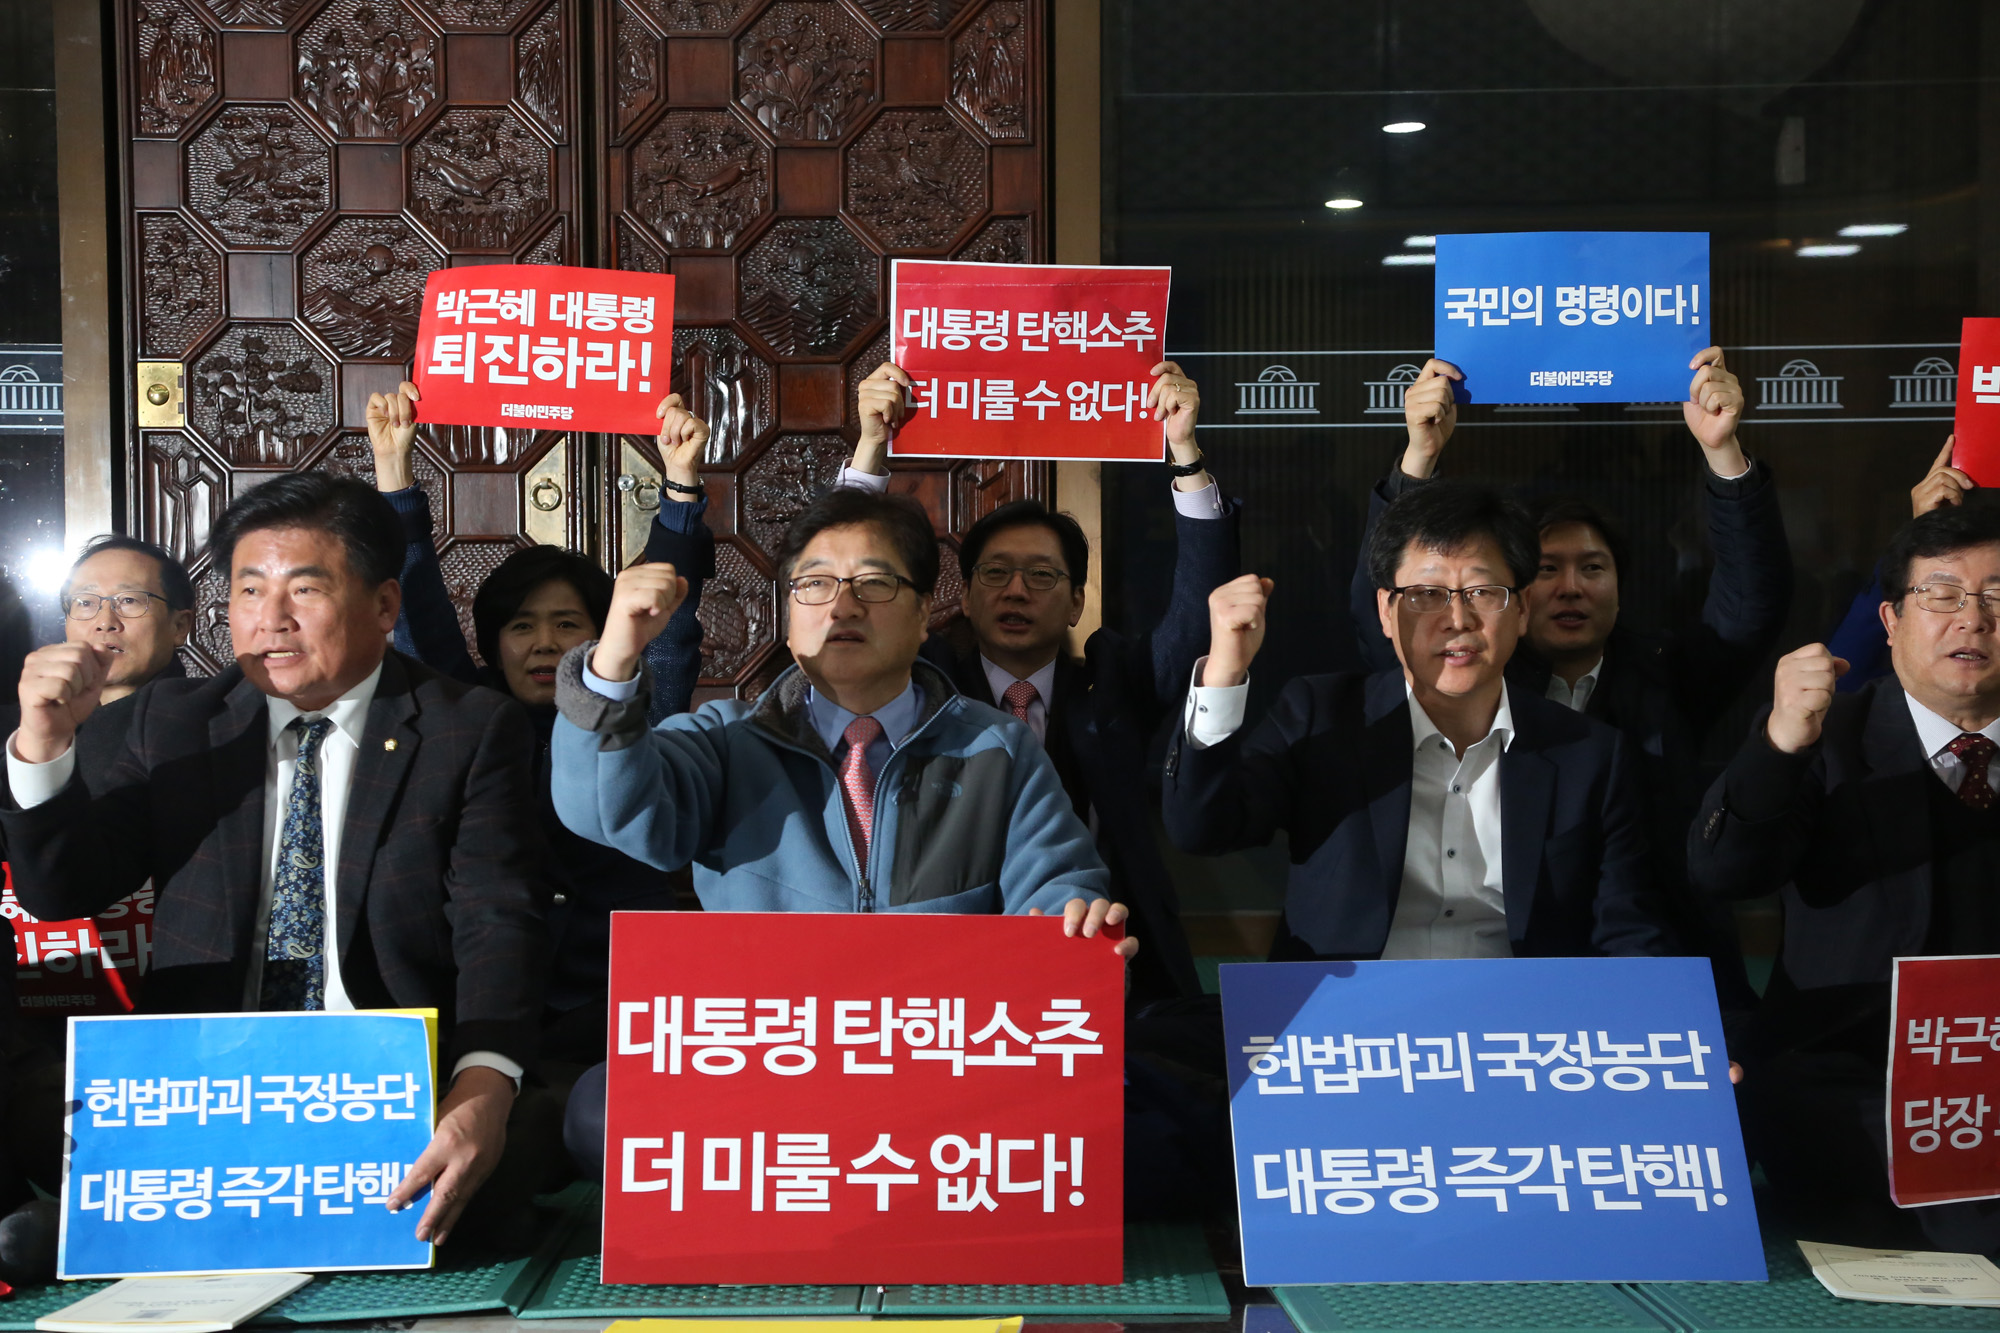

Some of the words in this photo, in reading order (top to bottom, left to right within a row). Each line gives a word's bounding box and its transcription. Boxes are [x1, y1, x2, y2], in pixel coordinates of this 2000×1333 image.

[436, 288, 537, 327] 박근혜
[549, 291, 655, 334] 대통령
[903, 306, 1010, 352] 대통령
[1017, 310, 1157, 353] 탄핵소추
[1444, 285, 1543, 327] 국민의
[1556, 284, 1700, 326] 명령이다!
[427, 331, 652, 393] 퇴진하라!
[1530, 371, 1614, 387] 더불어민주당
[501, 403, 574, 420] 더불어민주당
[905, 378, 939, 419] 더
[946, 378, 1020, 421] 미룰
[1022, 380, 1061, 421] 수
[1066, 380, 1149, 422] 없다!
[618, 996, 817, 1075] 대통령
[833, 997, 1103, 1077] 탄핵소추
[1242, 1032, 1475, 1095] 헌법파괴
[1477, 1030, 1711, 1092] 국정농단
[84, 1075, 251, 1128] 헌법파괴
[255, 1072, 420, 1123] 국정농단
[1904, 1094, 1991, 1153] 당장
[80, 1166, 214, 1222] 대통령
[218, 1164, 311, 1218] 즉각
[621, 1131, 685, 1212] 더
[702, 1131, 840, 1212] 미룰
[846, 1133, 919, 1212] 수
[930, 1133, 1085, 1213] 없다!
[1253, 1146, 1440, 1215] 대통령
[1445, 1144, 1574, 1212] 즉각
[1576, 1144, 1728, 1212] 탄핵!
